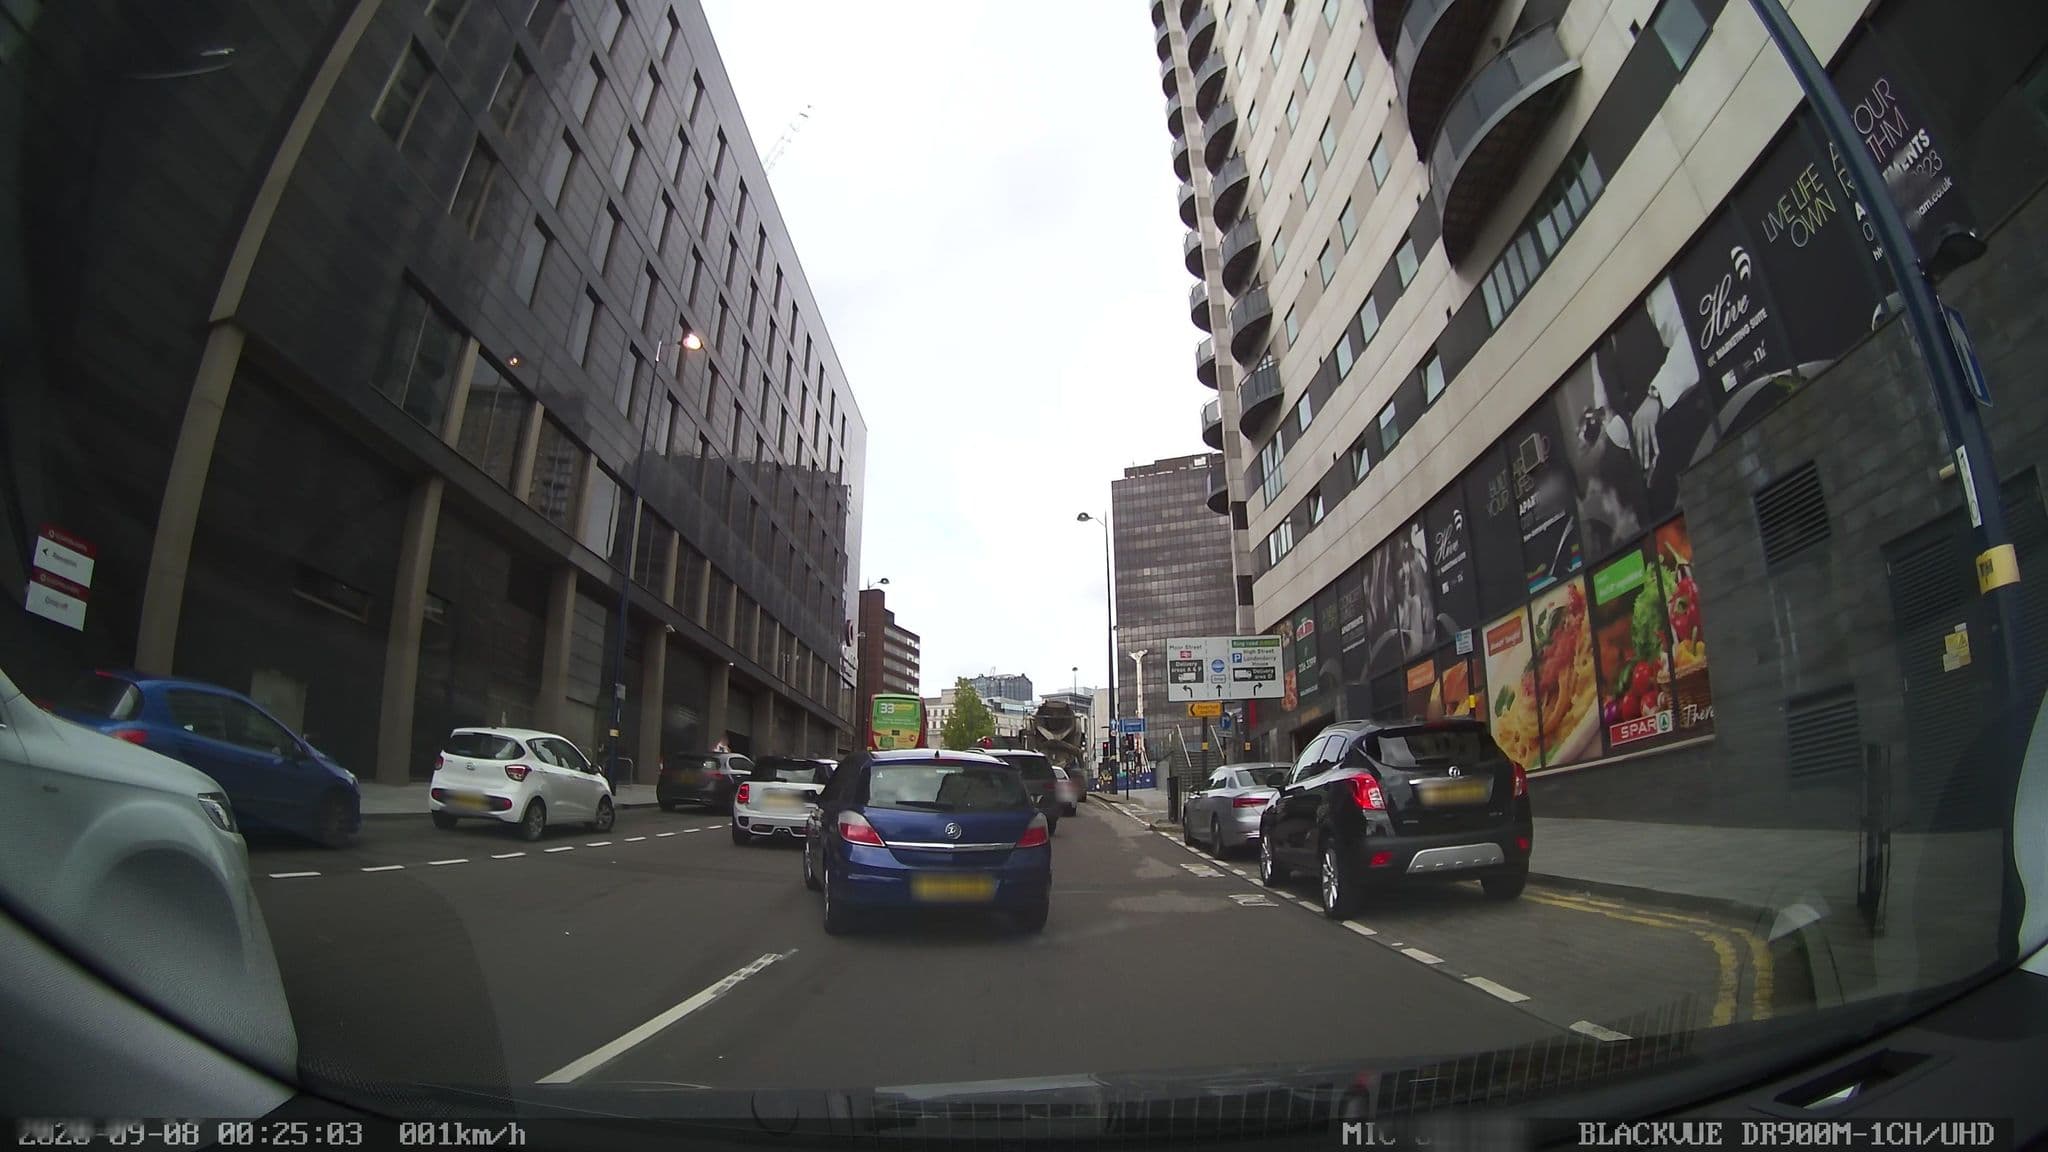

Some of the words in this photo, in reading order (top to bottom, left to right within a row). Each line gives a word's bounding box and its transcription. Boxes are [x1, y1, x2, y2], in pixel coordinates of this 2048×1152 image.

[1761, 195, 1796, 243] LIVE
[1791, 163, 1824, 210] LIFE
[1851, 78, 1896, 134] OUR
[1790, 188, 1837, 248] OWN
[1700, 273, 1750, 350] Hive
[1620, 718, 1657, 739] SPAR
